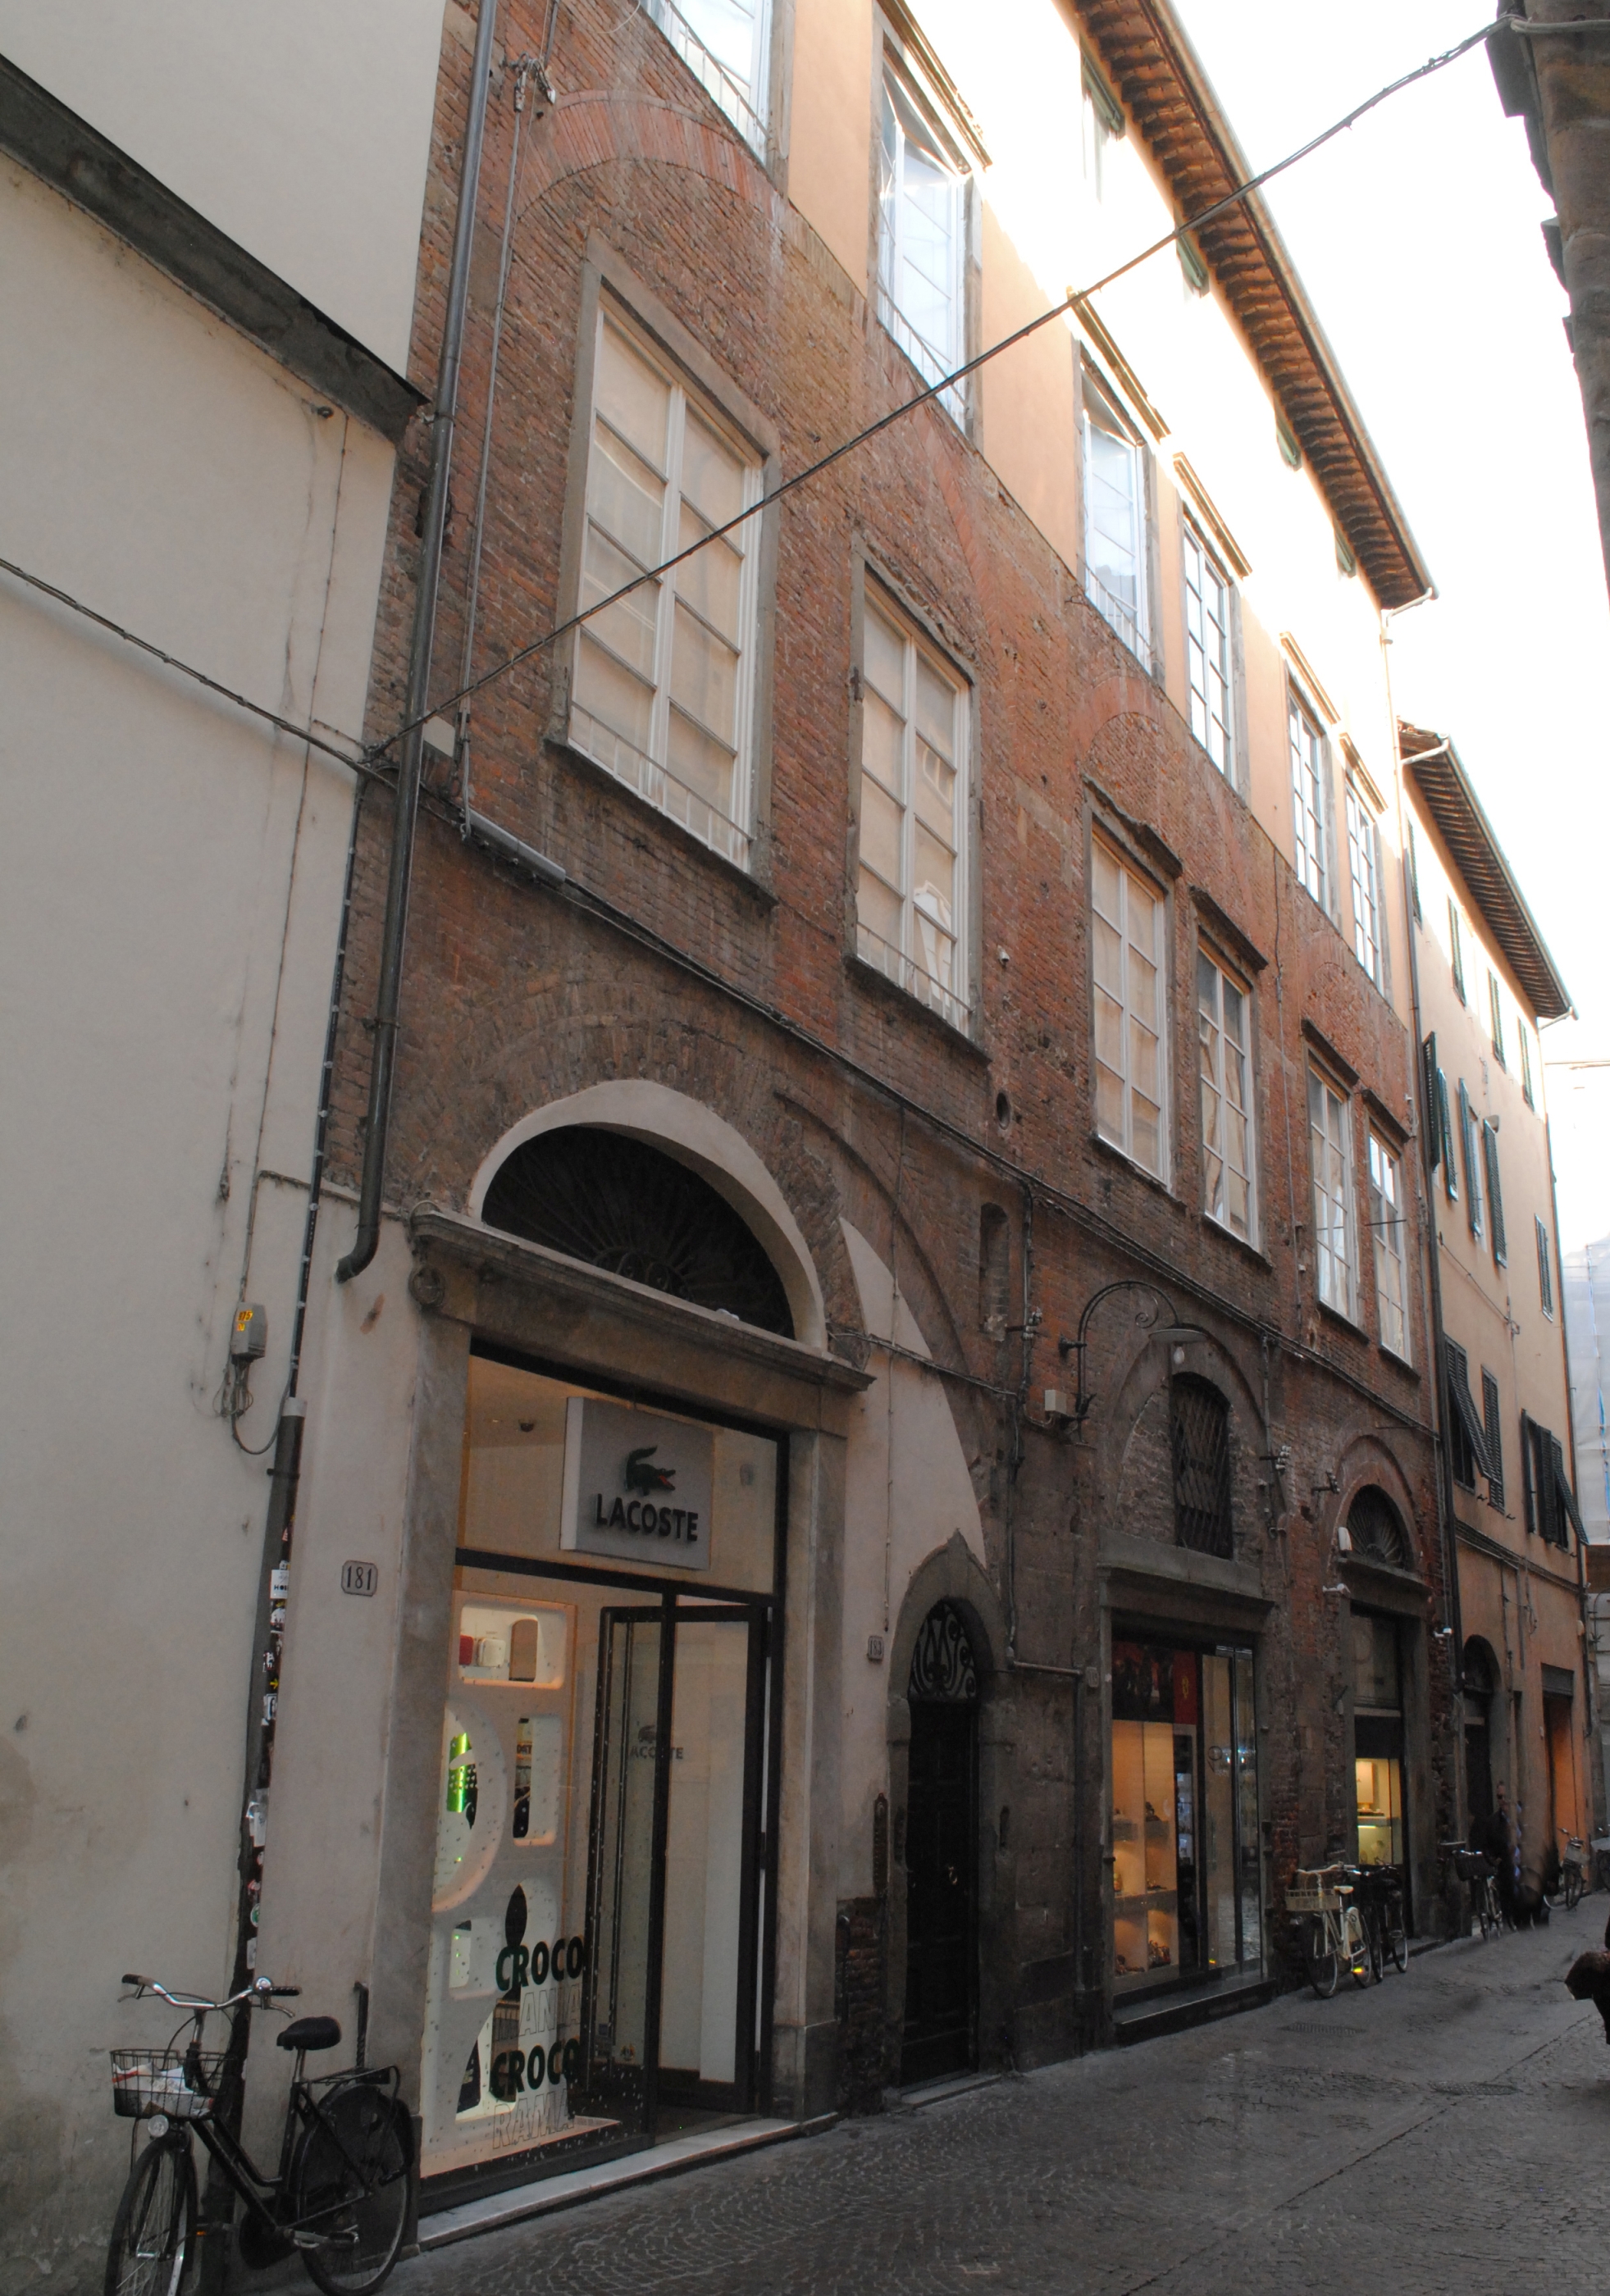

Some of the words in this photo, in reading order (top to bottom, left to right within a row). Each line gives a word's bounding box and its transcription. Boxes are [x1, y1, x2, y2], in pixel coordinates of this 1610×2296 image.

[596, 1493, 699, 1542] LACOSTE
[347, 1565, 372, 1591] 181
[869, 1639, 883, 1656] 183
[495, 1936, 585, 1992] CROCO
[490, 2038, 579, 2100] CROCO
